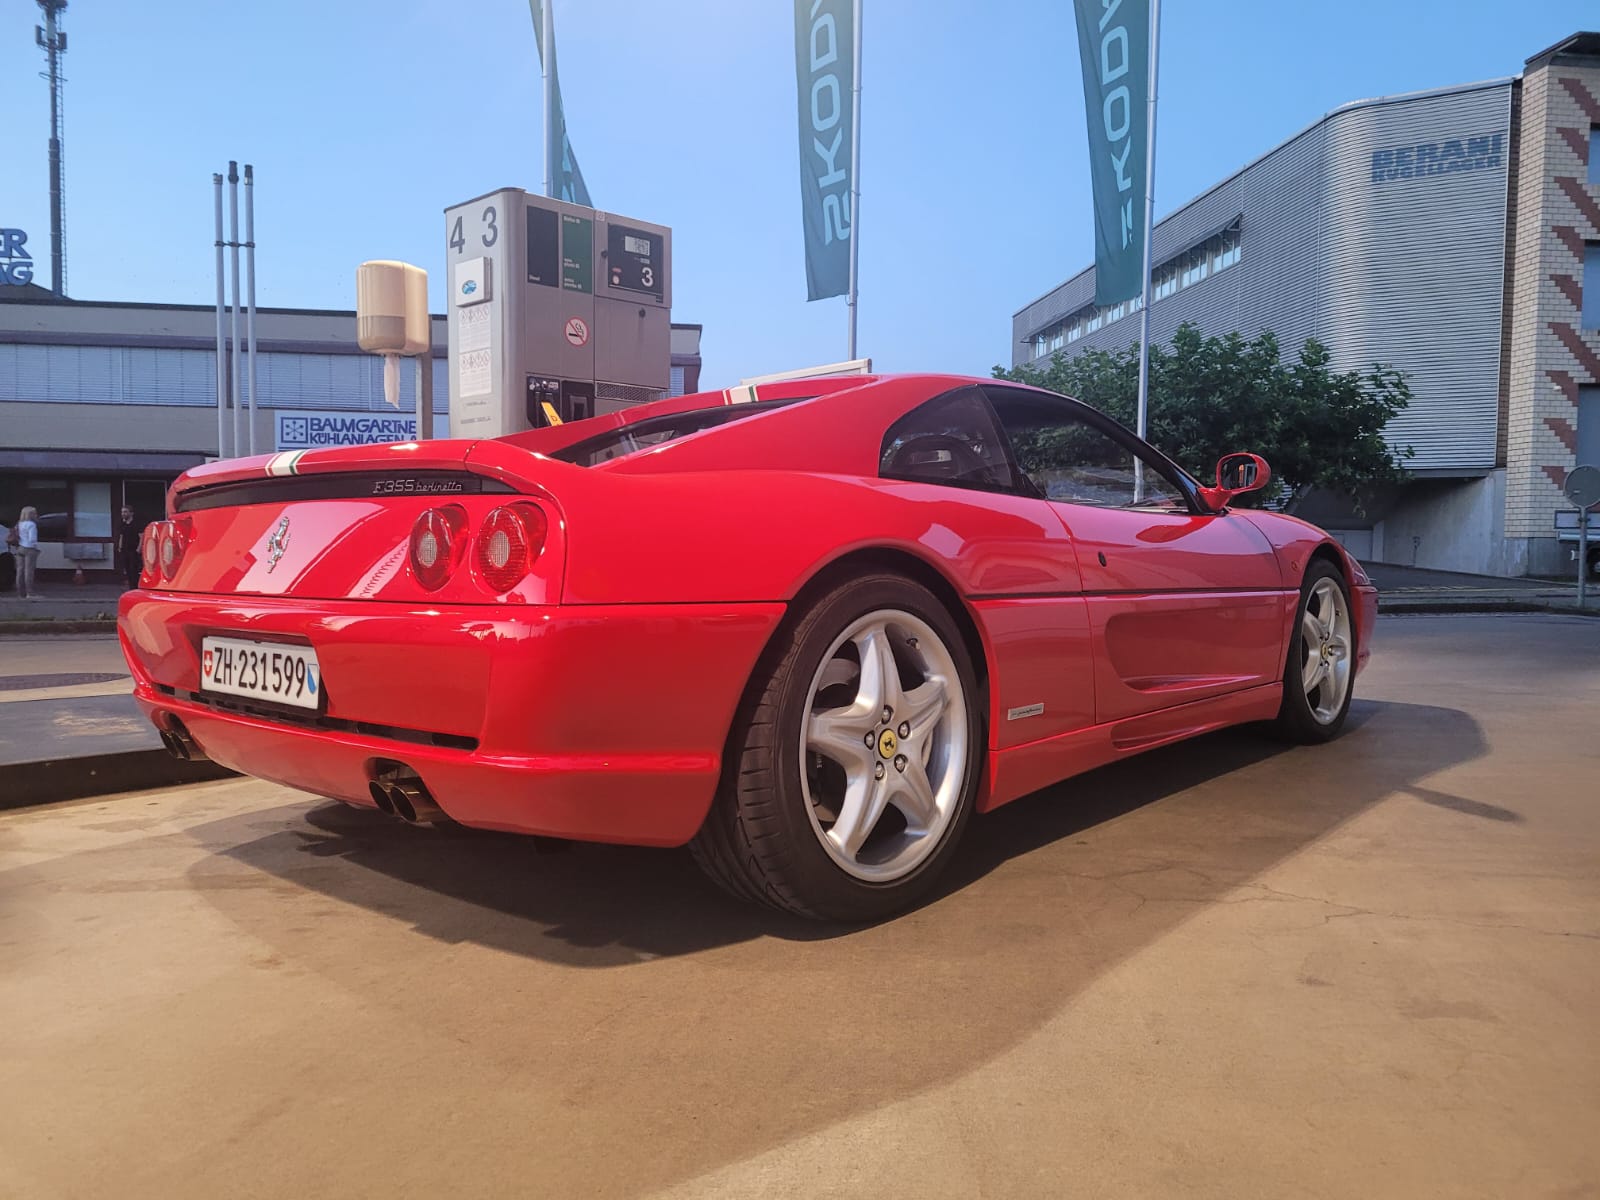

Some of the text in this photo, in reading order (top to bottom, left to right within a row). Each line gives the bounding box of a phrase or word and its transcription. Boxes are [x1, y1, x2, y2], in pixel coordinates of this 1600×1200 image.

[1372, 134, 1503, 169] BERANI
[450, 206, 498, 254] 4 3
[641, 267, 654, 287] 3
[373, 480, 462, 493] F355 berlinetta
